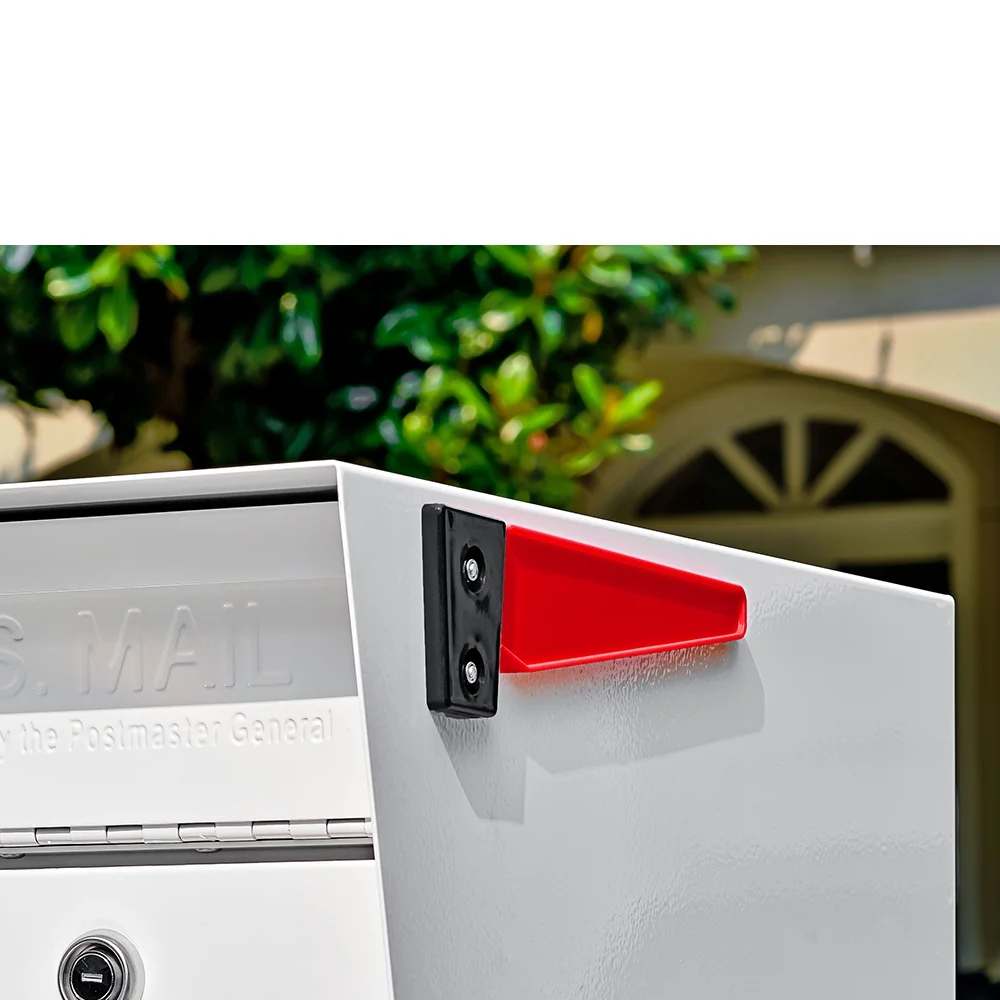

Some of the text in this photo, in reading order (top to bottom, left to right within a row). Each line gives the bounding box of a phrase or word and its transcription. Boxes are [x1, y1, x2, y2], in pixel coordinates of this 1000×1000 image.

[77, 601, 293, 694] MAIL
[19, 720, 59, 754] the
[67, 714, 222, 752] Postmaster
[231, 709, 334, 746] General
